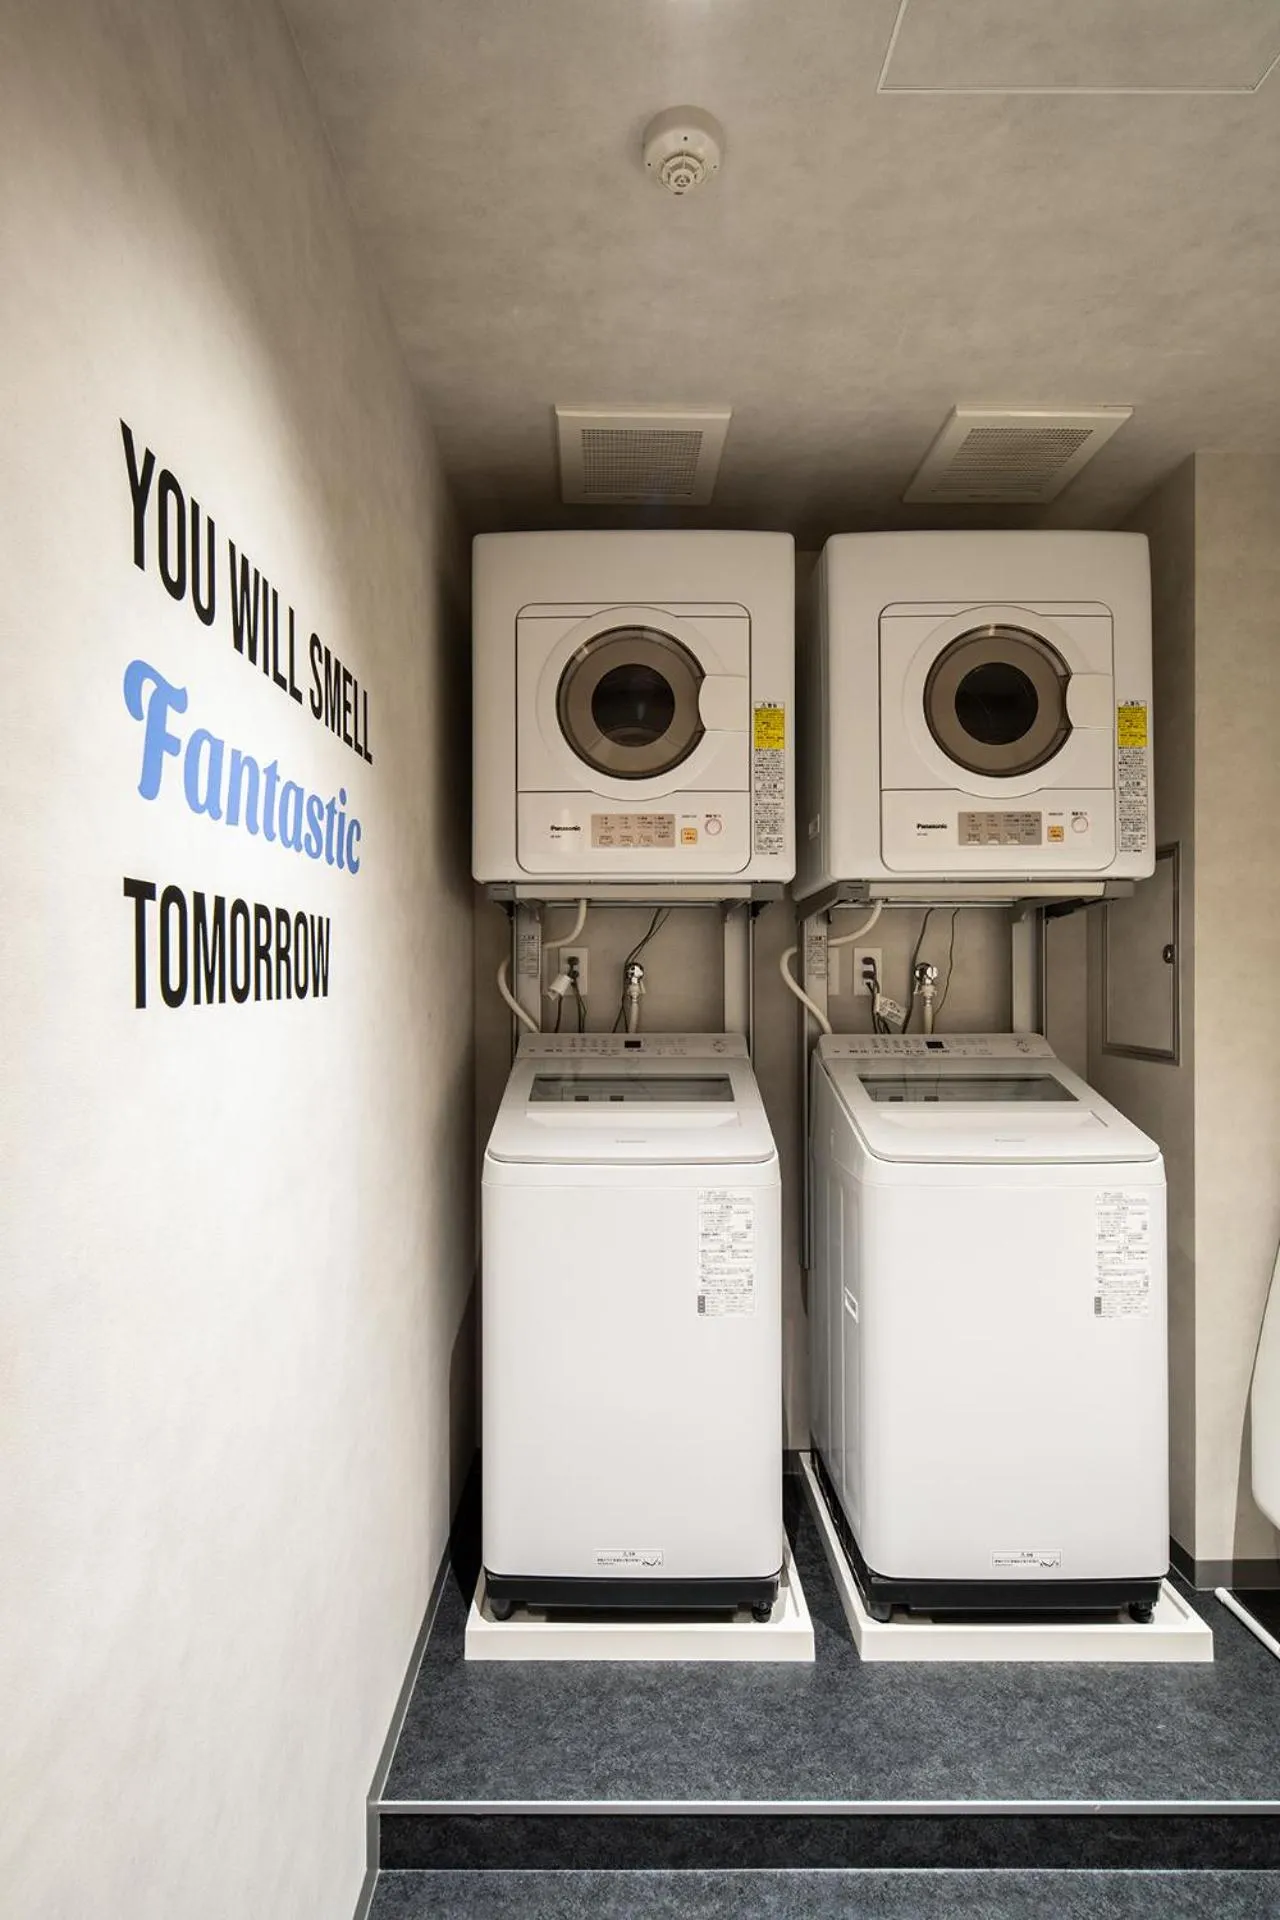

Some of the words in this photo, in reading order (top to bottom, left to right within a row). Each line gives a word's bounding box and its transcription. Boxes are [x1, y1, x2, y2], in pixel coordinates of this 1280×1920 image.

[120, 417, 216, 626] YOU
[228, 538, 303, 705] WILL
[308, 632, 373, 765] SMELL
[123, 659, 362, 875] Fantastic
[123, 876, 331, 1010] TOMORROW
